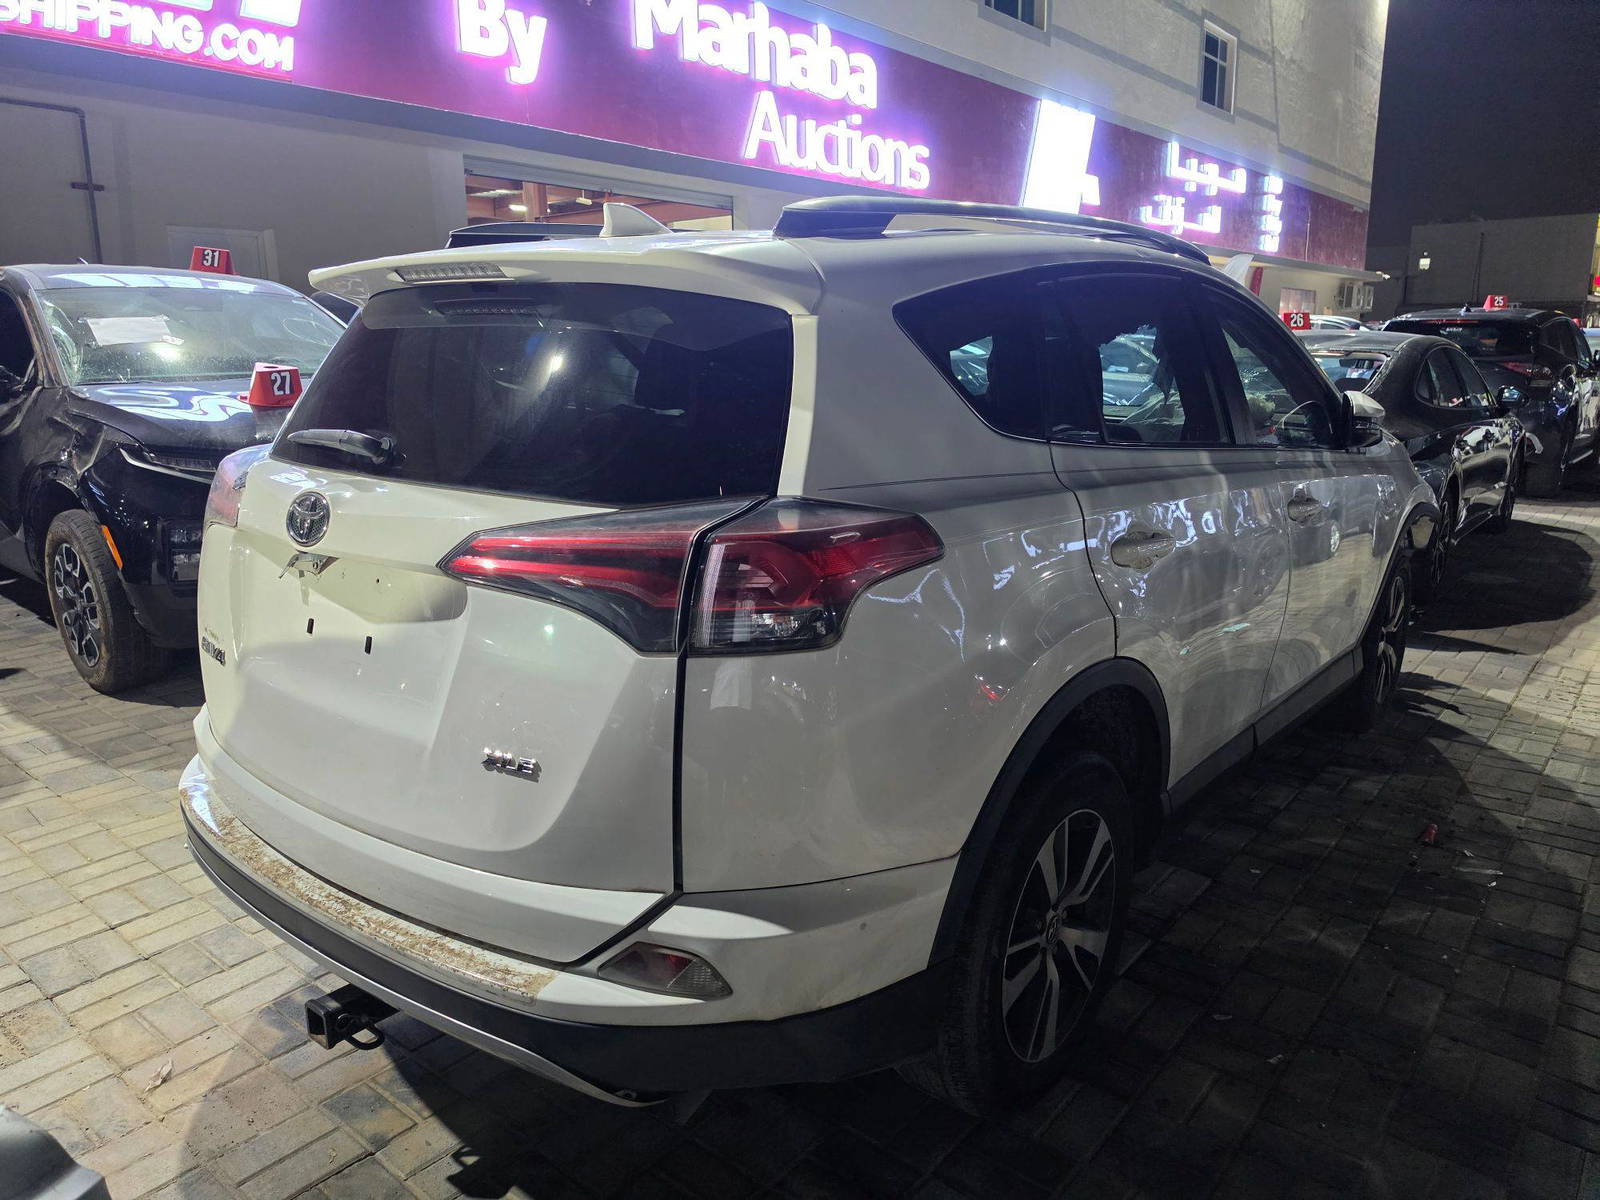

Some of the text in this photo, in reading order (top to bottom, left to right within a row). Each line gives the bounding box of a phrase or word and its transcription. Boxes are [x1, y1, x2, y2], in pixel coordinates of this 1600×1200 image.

[457, 0, 548, 85] By
[634, 0, 878, 109] Marhaba
[744, 90, 931, 190] Auctions
[203, 249, 220, 268] 31
[1494, 296, 1504, 306] 25
[1290, 313, 1304, 327] 26
[270, 371, 292, 396] 27
